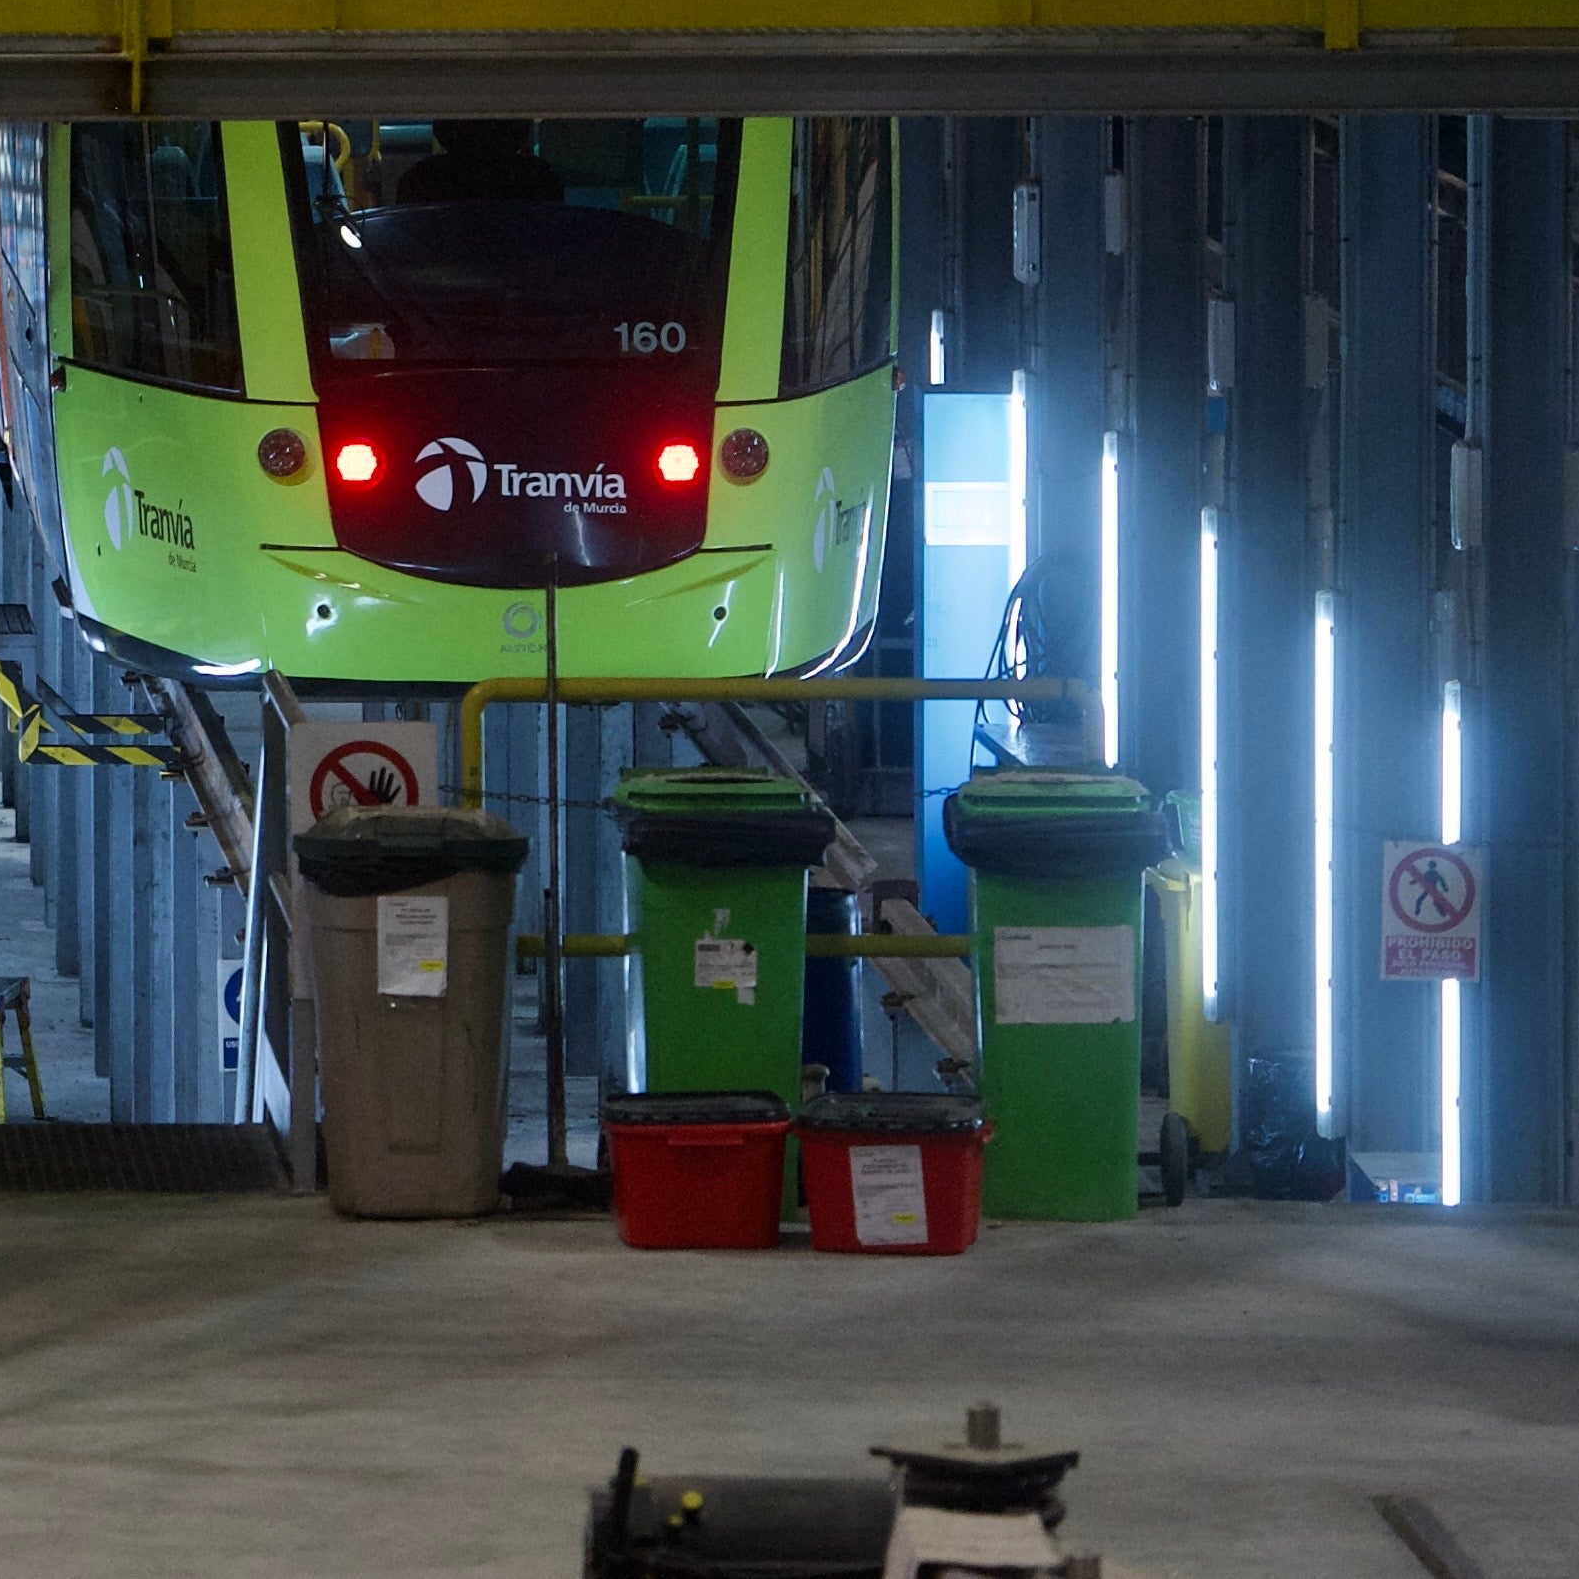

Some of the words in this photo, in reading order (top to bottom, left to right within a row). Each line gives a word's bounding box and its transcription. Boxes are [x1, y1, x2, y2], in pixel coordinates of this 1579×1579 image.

[614, 321, 686, 354] 160
[493, 463, 626, 500] Tranvía
[564, 501, 580, 513] de
[583, 501, 627, 514] Murcia
[134, 489, 195, 550] Tranvía
[1388, 937, 1473, 949] PROHIBIDO
[1421, 949, 1461, 961] PASO
